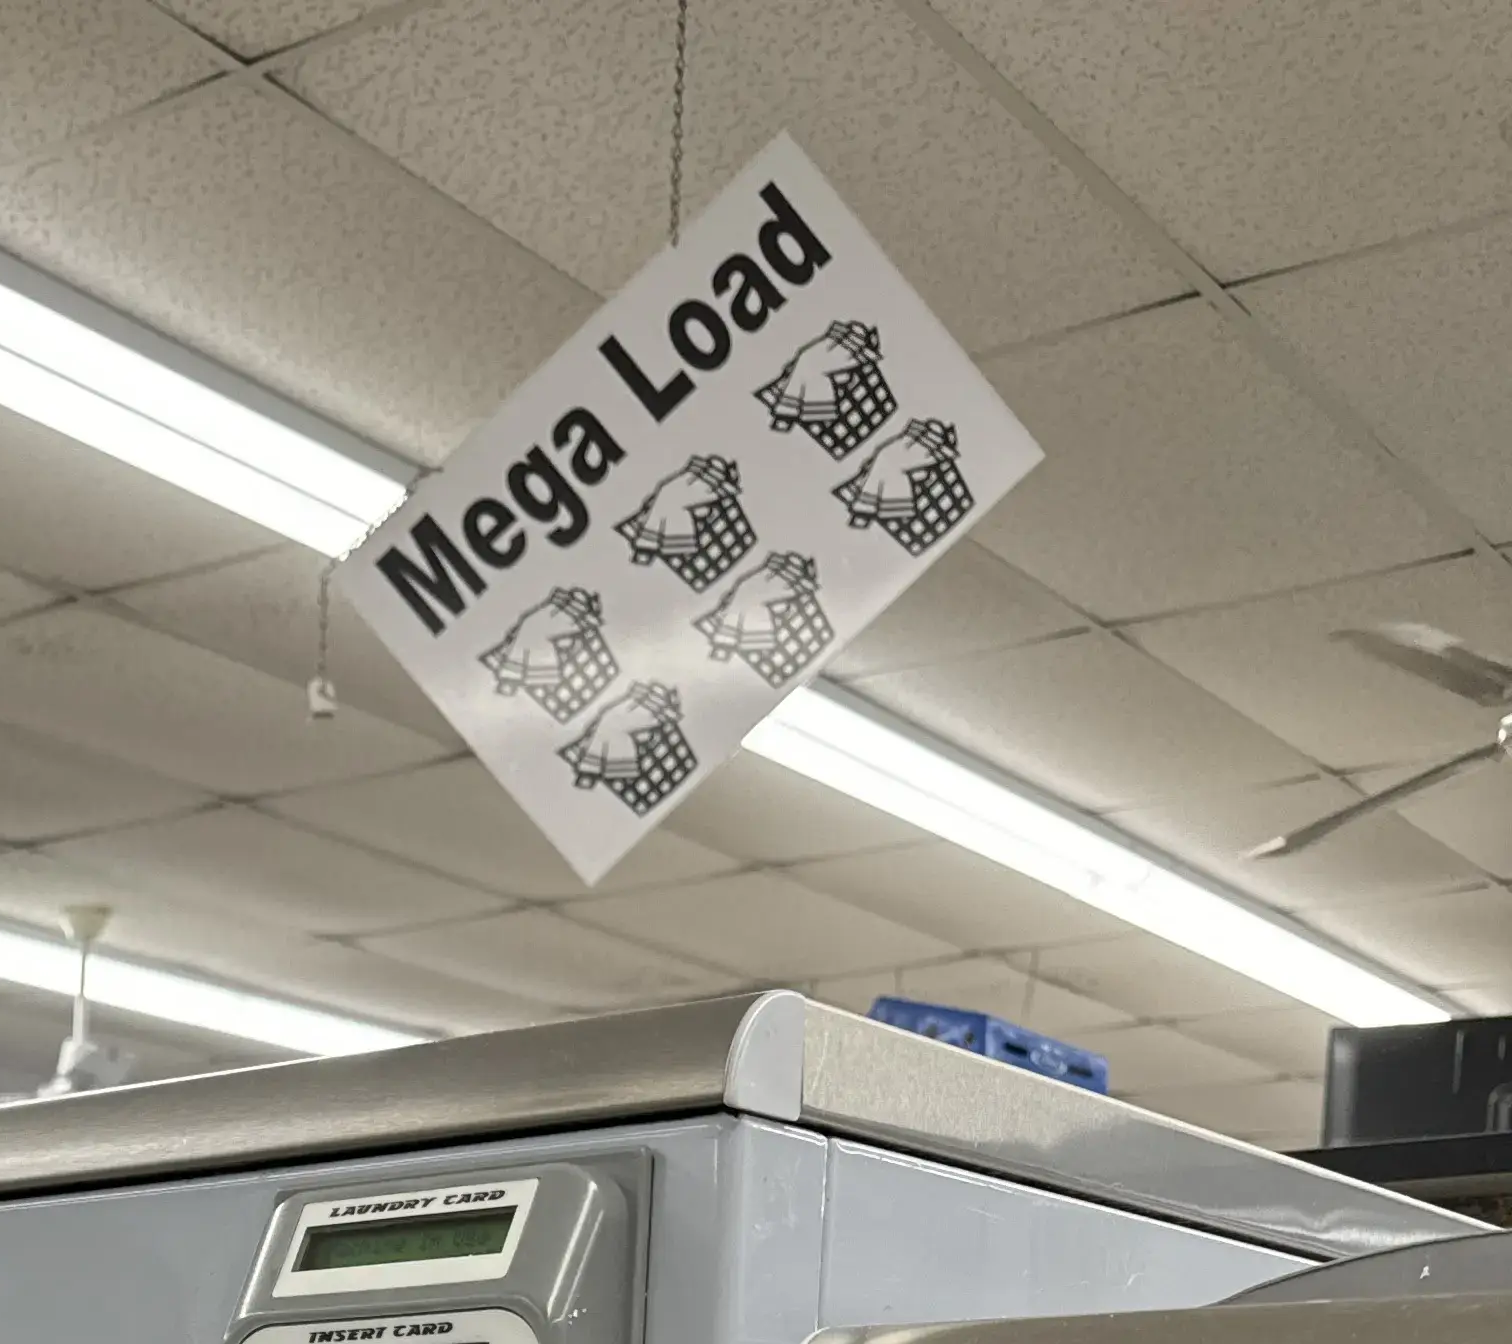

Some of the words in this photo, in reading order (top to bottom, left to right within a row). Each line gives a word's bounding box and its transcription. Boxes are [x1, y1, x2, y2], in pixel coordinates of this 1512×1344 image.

[375, 406, 627, 637] Mega
[599, 181, 832, 423] Load
[329, 1197, 437, 1218] LAUNDRY
[444, 1190, 506, 1206] CARD
[309, 1327, 387, 1343] INSERT
[393, 1322, 453, 1337] CARD
